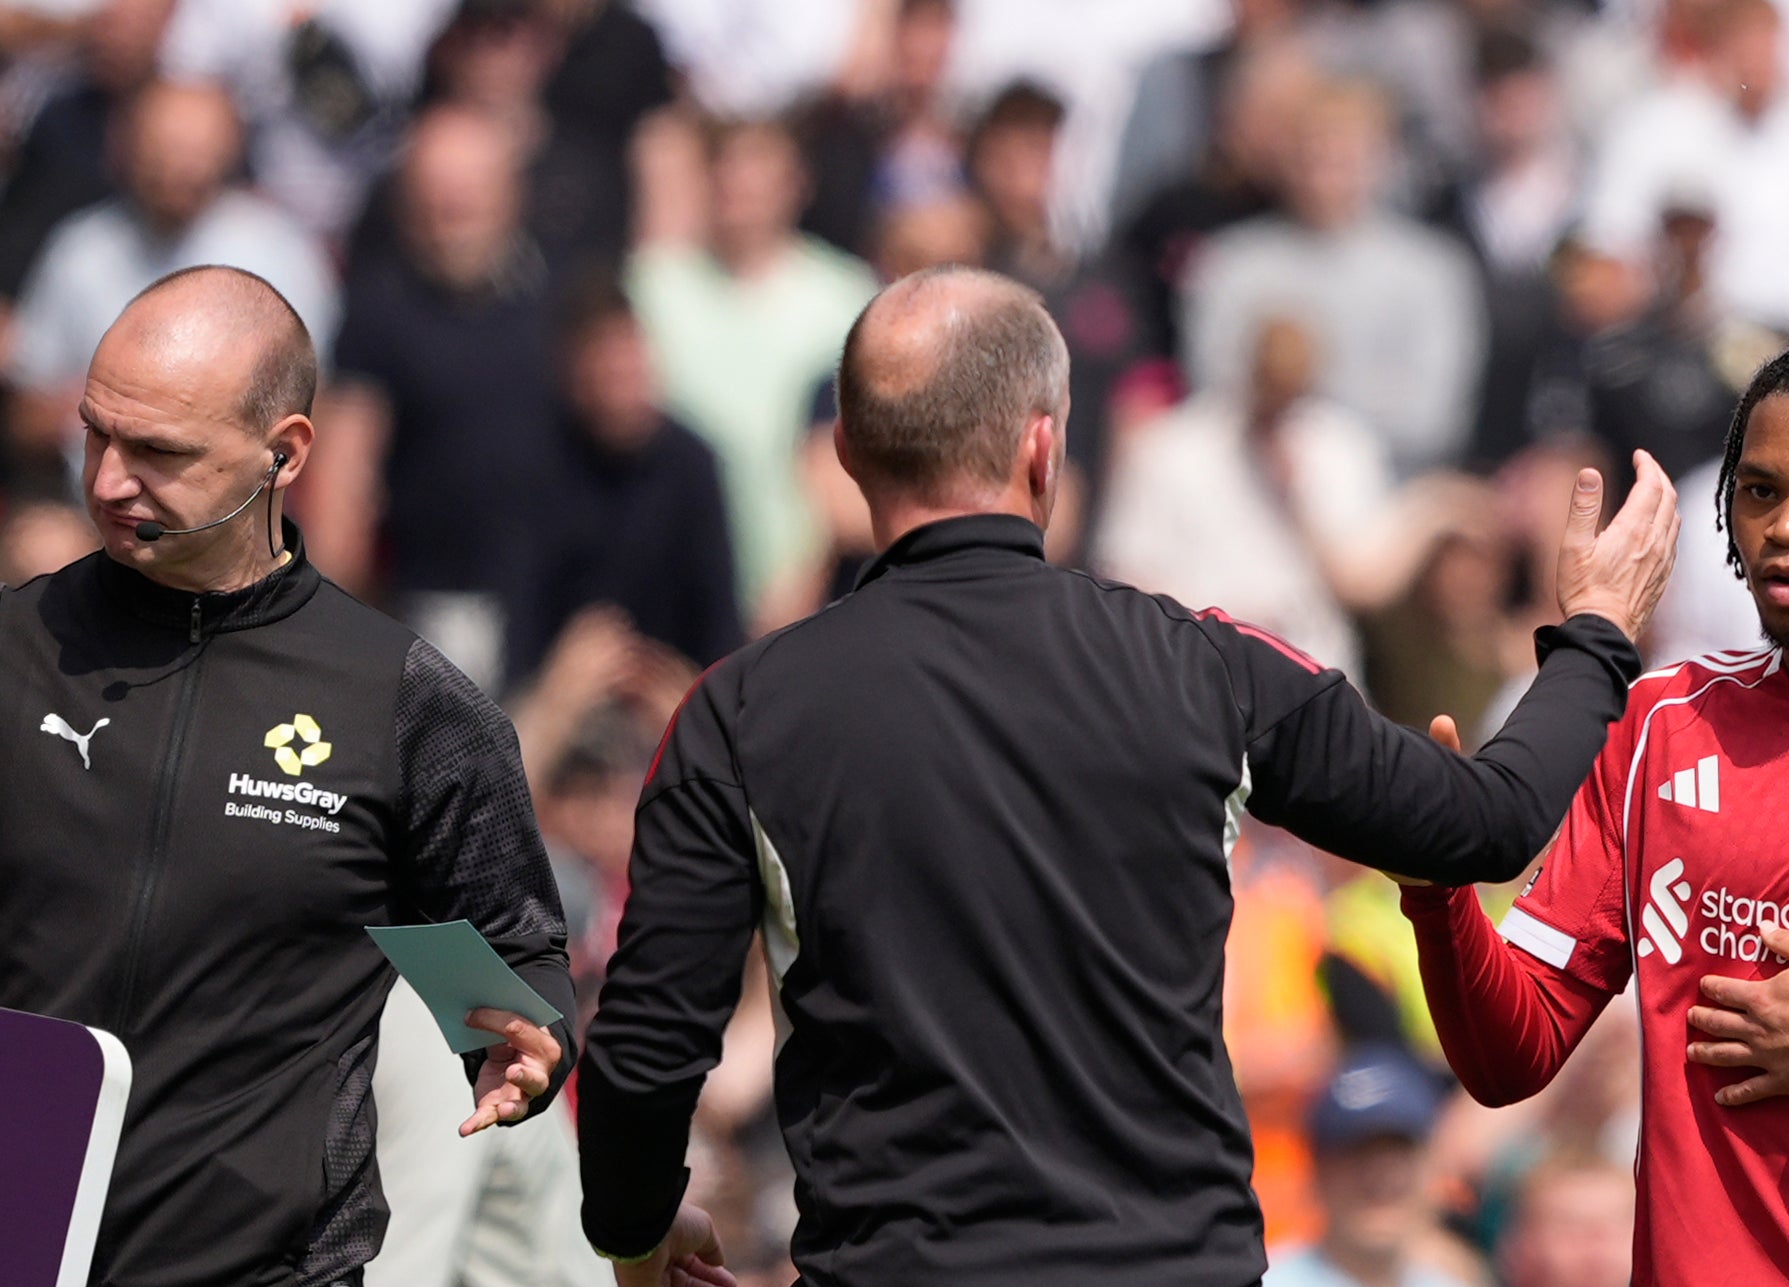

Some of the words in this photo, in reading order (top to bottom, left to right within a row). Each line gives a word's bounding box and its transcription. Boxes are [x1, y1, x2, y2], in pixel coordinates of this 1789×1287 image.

[228, 773, 348, 815] HuwsGray
[225, 802, 282, 824] Building
[284, 809, 340, 833] Supplies
